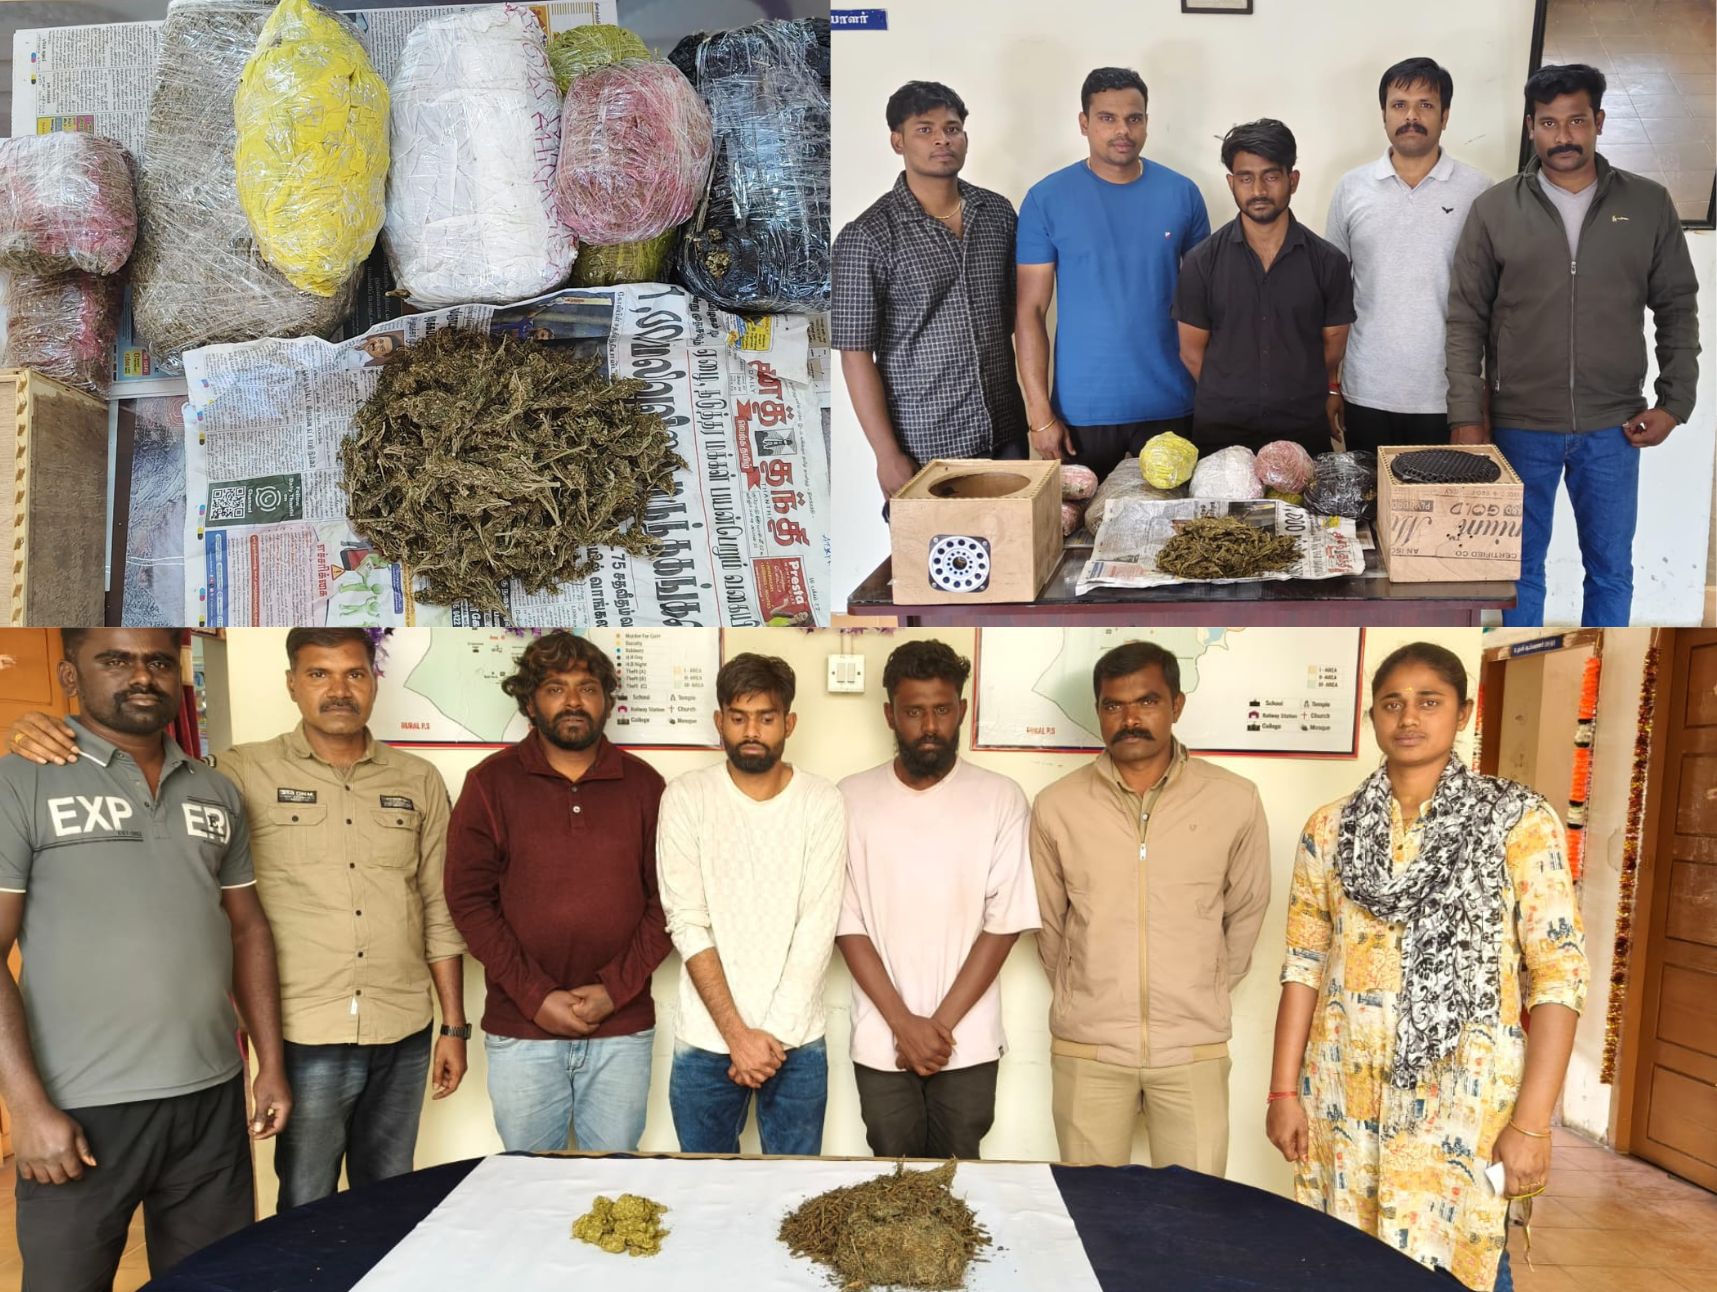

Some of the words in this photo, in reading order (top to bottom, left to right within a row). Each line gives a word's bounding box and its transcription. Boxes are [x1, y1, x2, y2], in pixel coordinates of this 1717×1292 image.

[747, 369, 756, 394] DAILY
[705, 441, 735, 482] மக்கள்
[739, 447, 751, 469] தமிழ்
[1449, 502, 1500, 516] GOLD
[611, 553, 626, 569] 75
[611, 572, 635, 615] சதவீதம்
[788, 561, 805, 605] Presta
[47, 796, 133, 837] EXP
